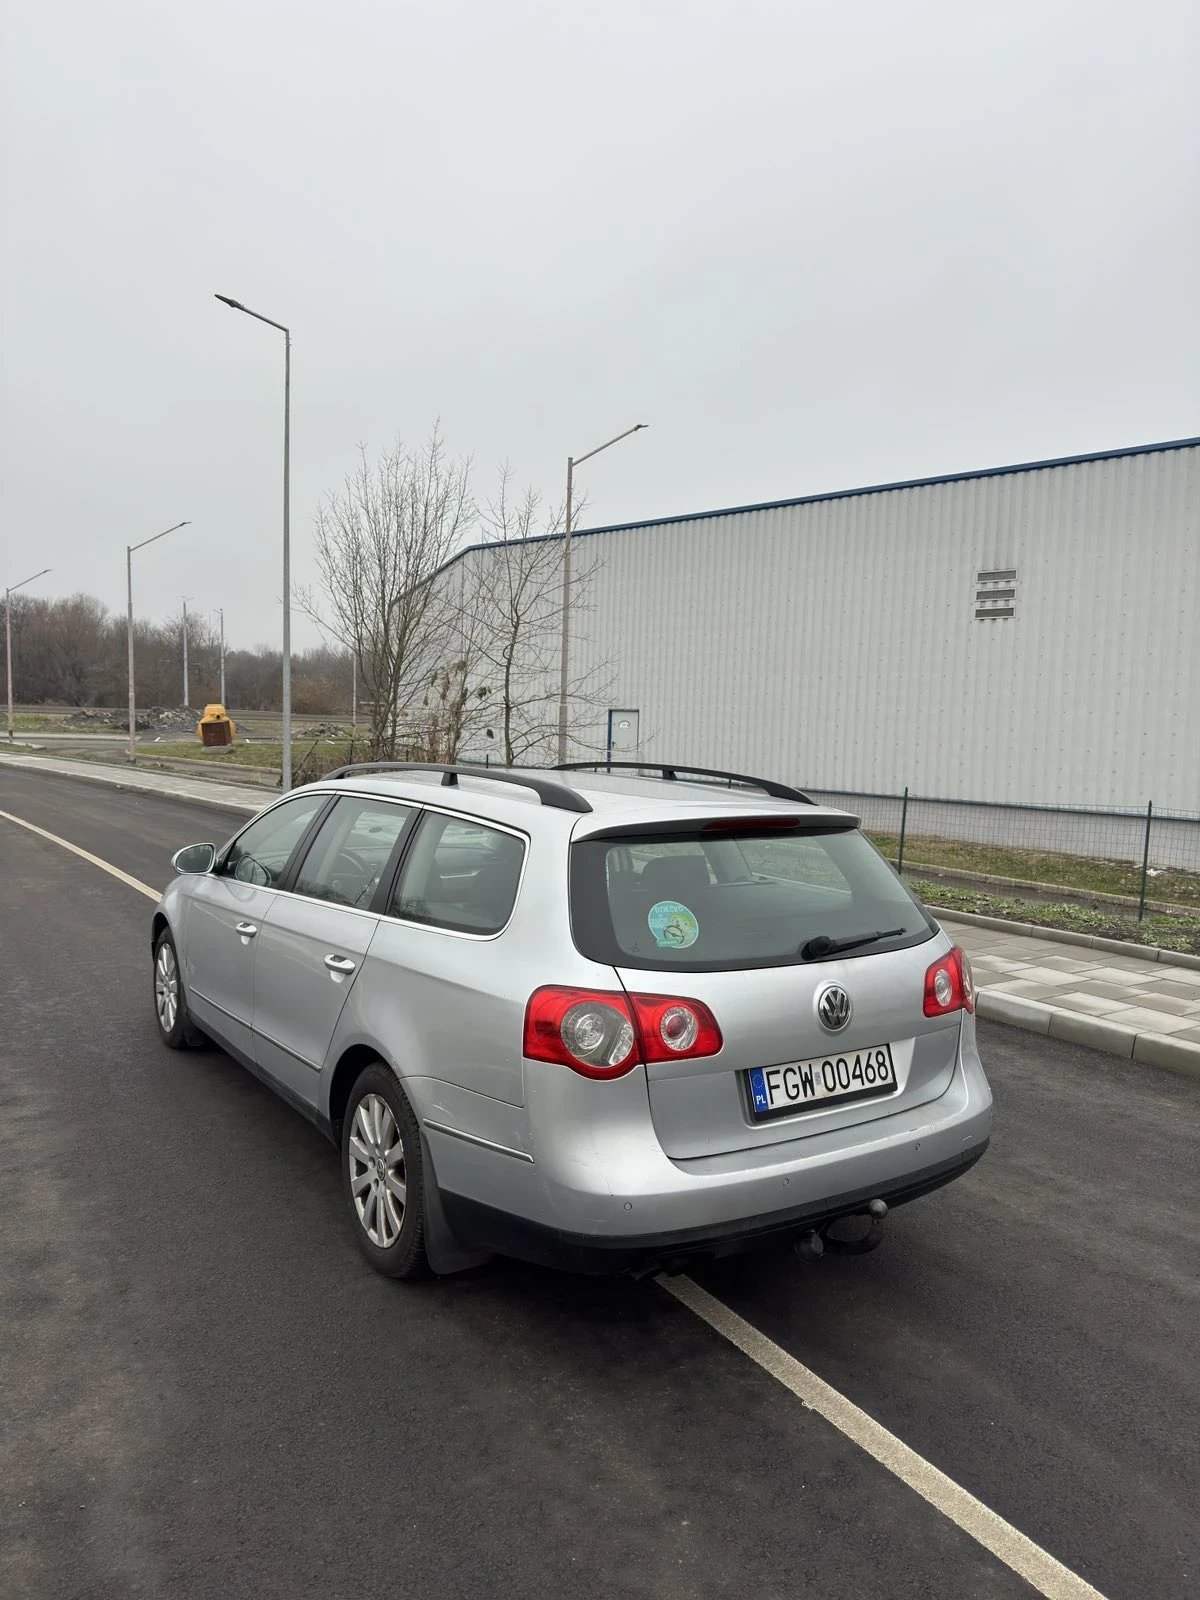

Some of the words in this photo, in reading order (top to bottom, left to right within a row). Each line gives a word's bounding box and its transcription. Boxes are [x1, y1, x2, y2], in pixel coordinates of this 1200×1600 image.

[766, 1063, 815, 1105] FGW
[822, 1050, 888, 1092] 00468
[756, 1095, 767, 1105] PL
